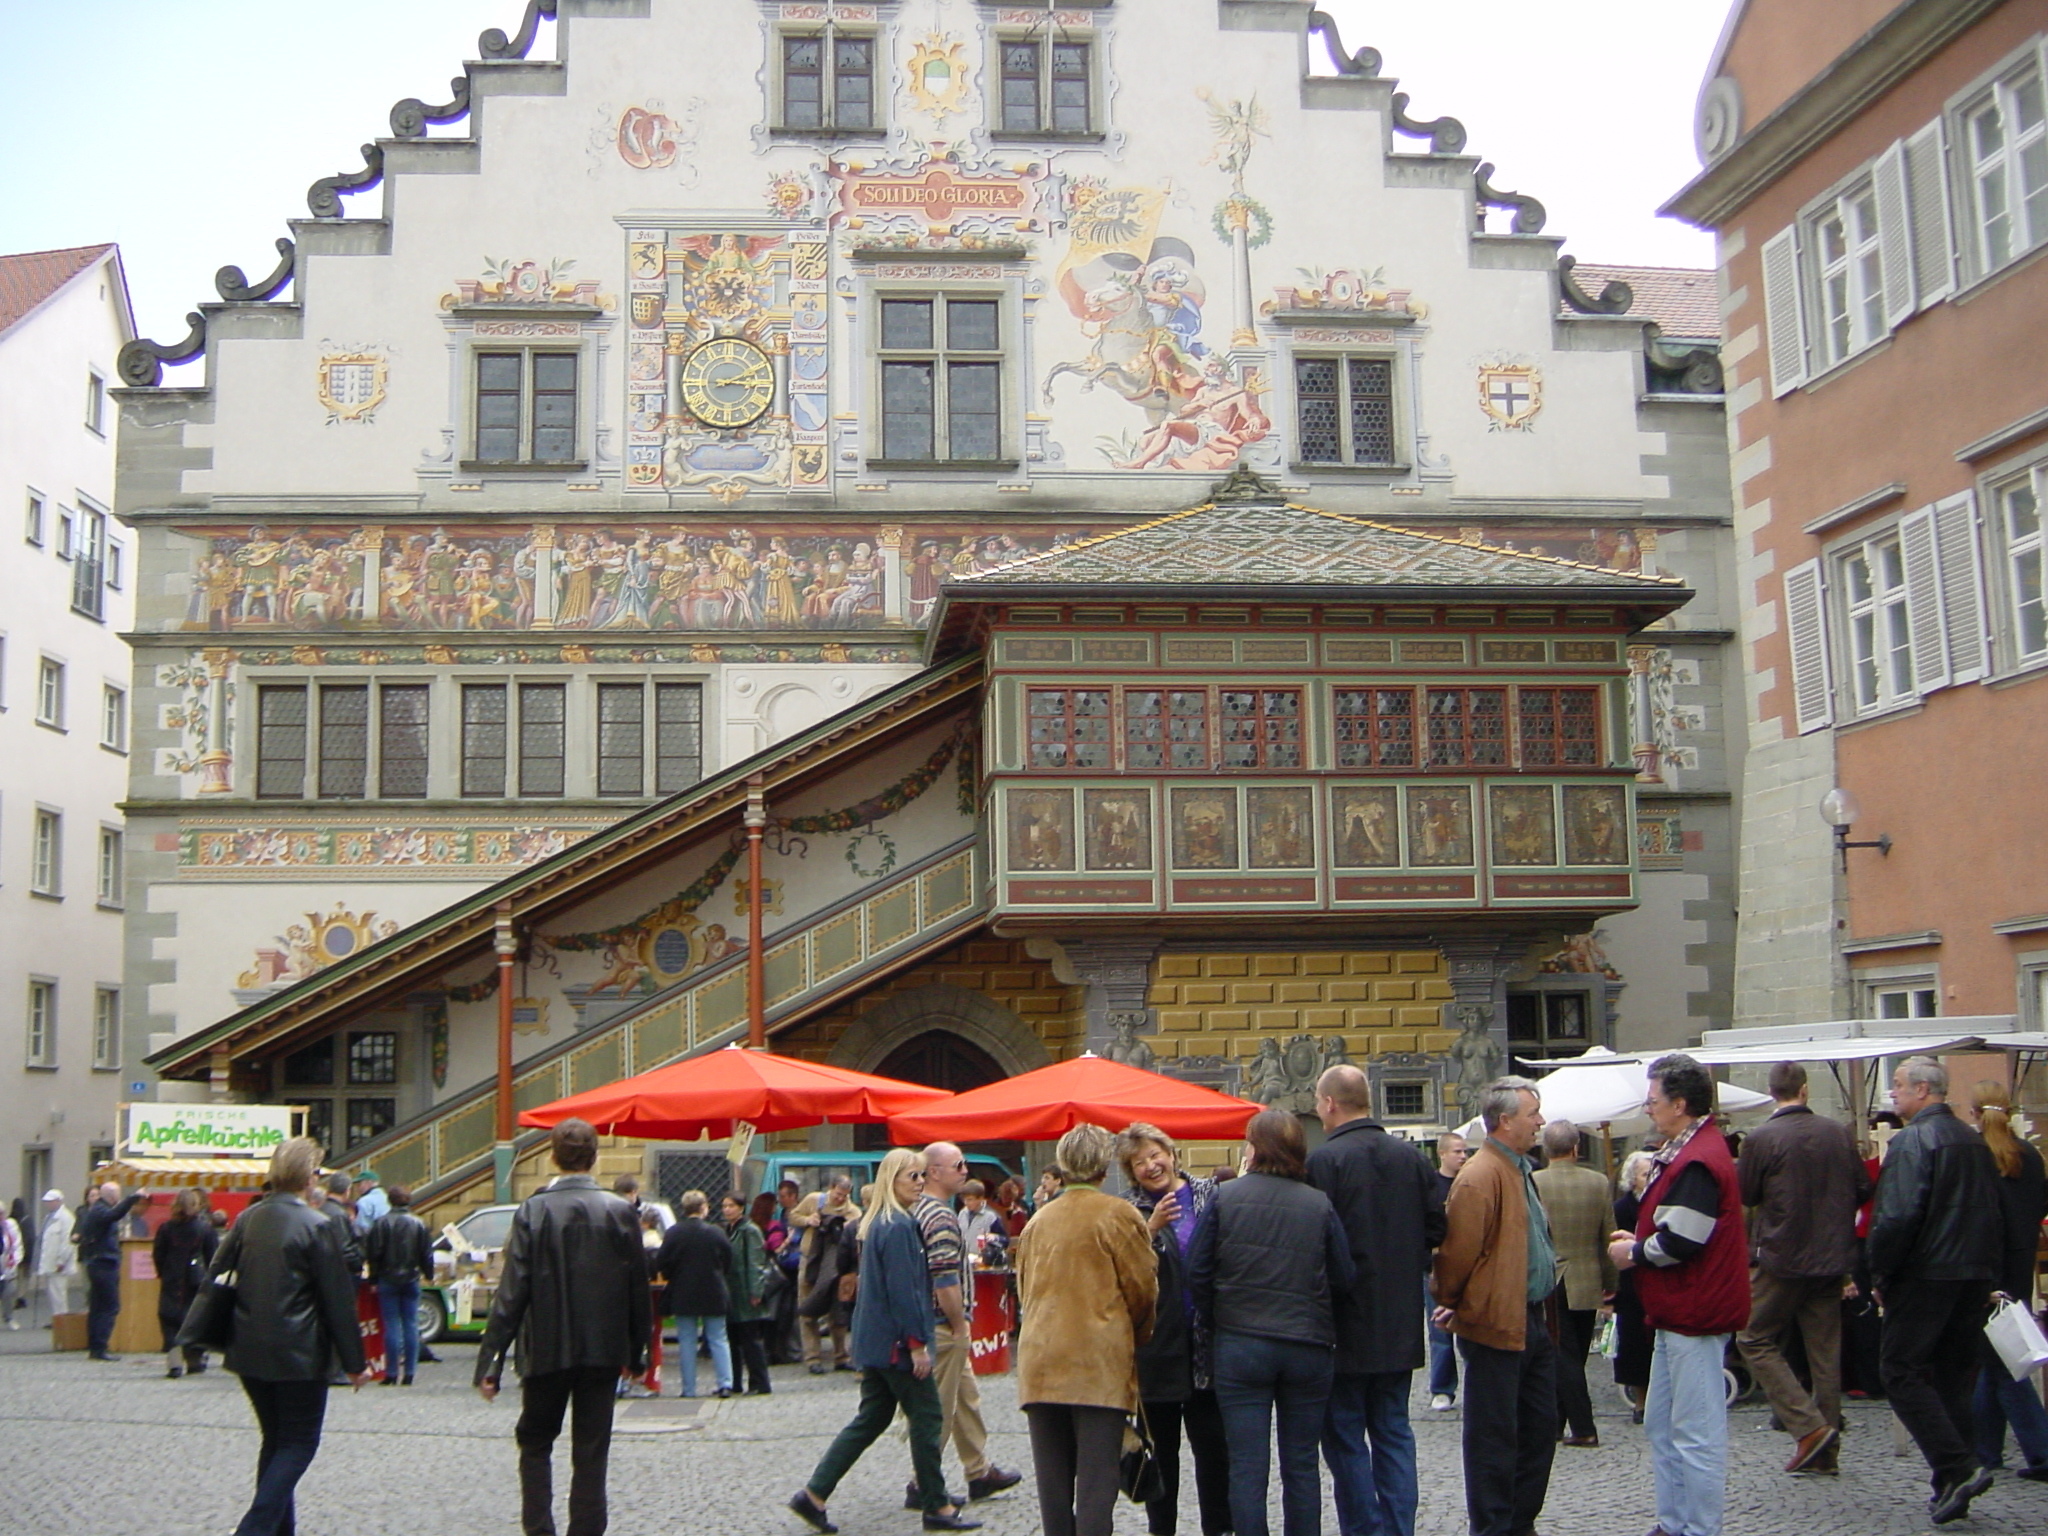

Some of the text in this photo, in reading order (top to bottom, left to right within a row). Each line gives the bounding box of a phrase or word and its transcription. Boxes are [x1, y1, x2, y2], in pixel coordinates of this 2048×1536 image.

[864, 185, 1009, 206] SOLI DEO GLORIA
[175, 1110, 248, 1120] FRISCHE
[136, 1120, 284, 1148] Apfelküchle
